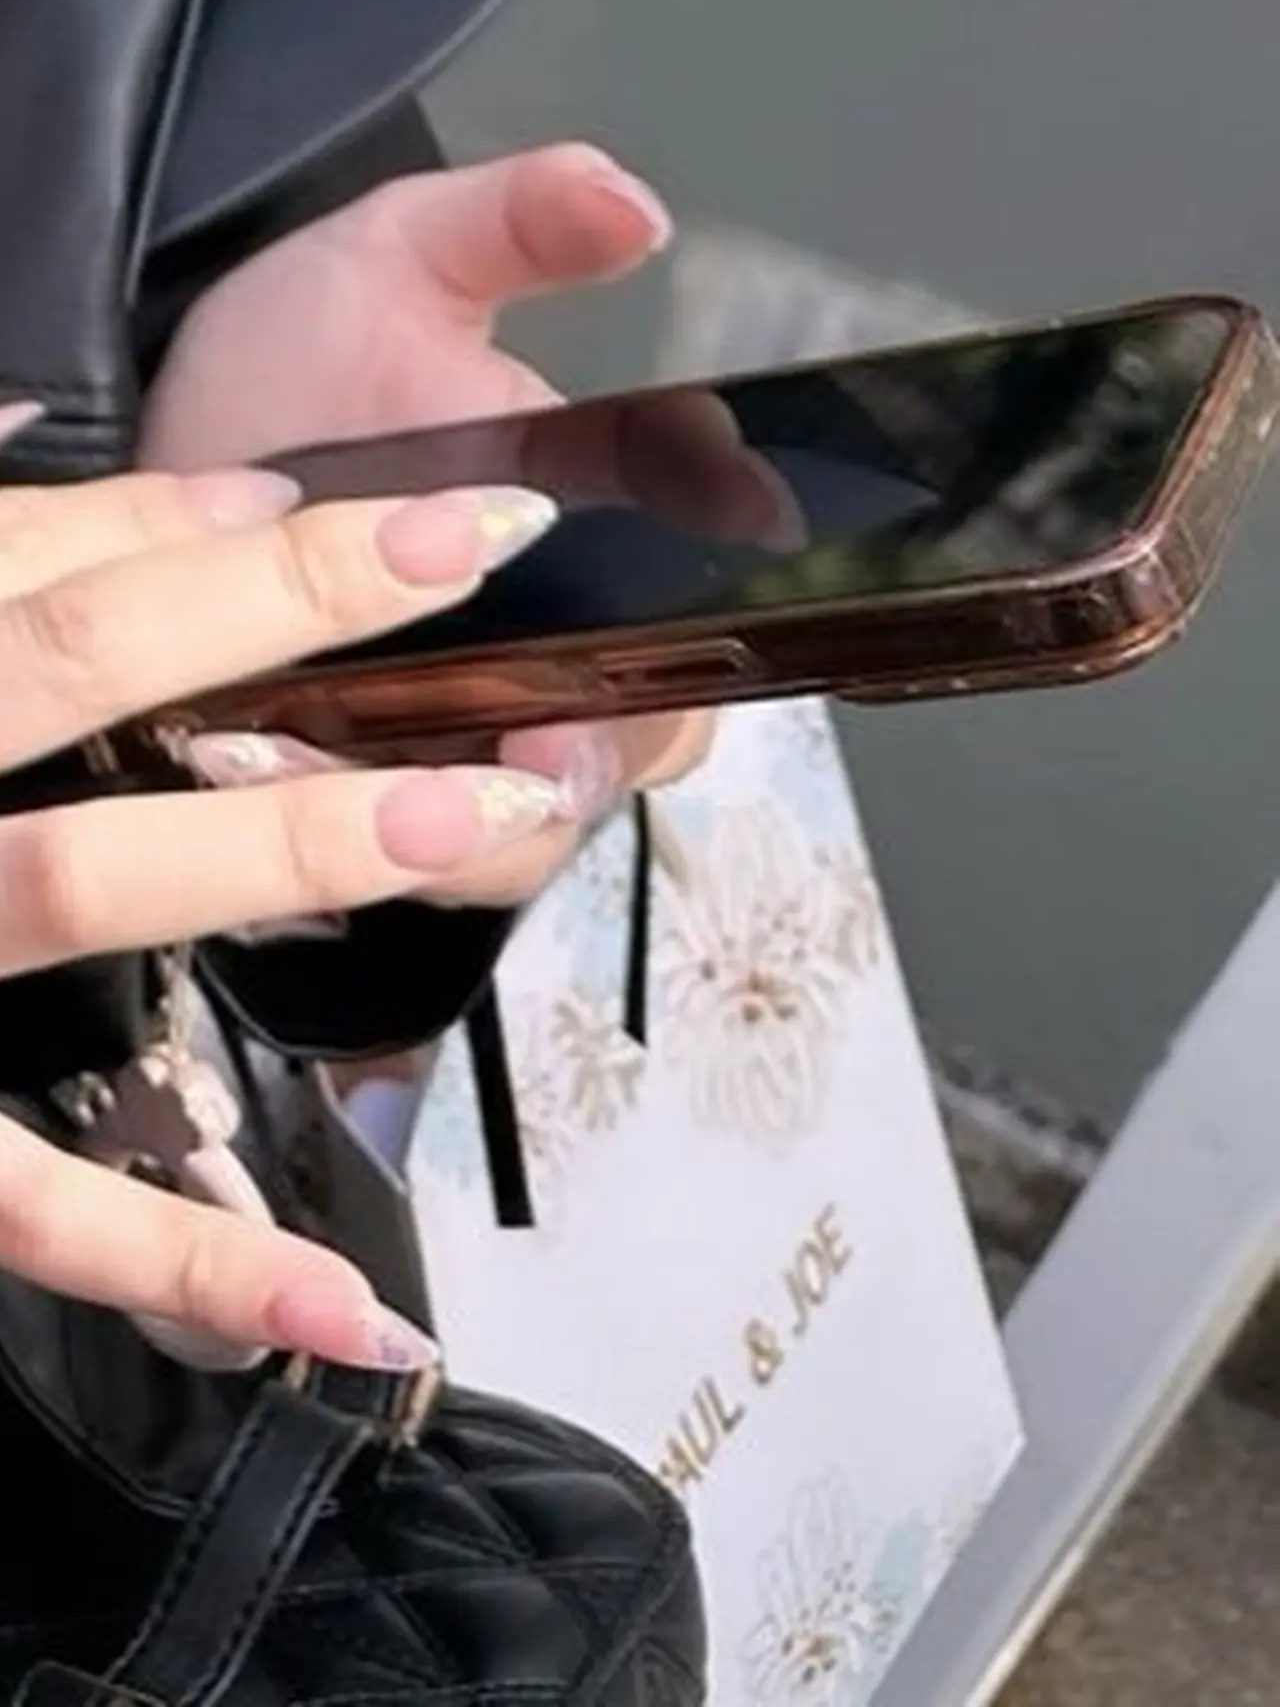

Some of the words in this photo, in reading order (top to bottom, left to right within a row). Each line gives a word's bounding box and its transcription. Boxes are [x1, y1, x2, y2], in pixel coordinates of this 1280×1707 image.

[658, 1375, 746, 1487] AUL
[743, 1317, 785, 1388] &
[783, 1200, 853, 1340] JOE
